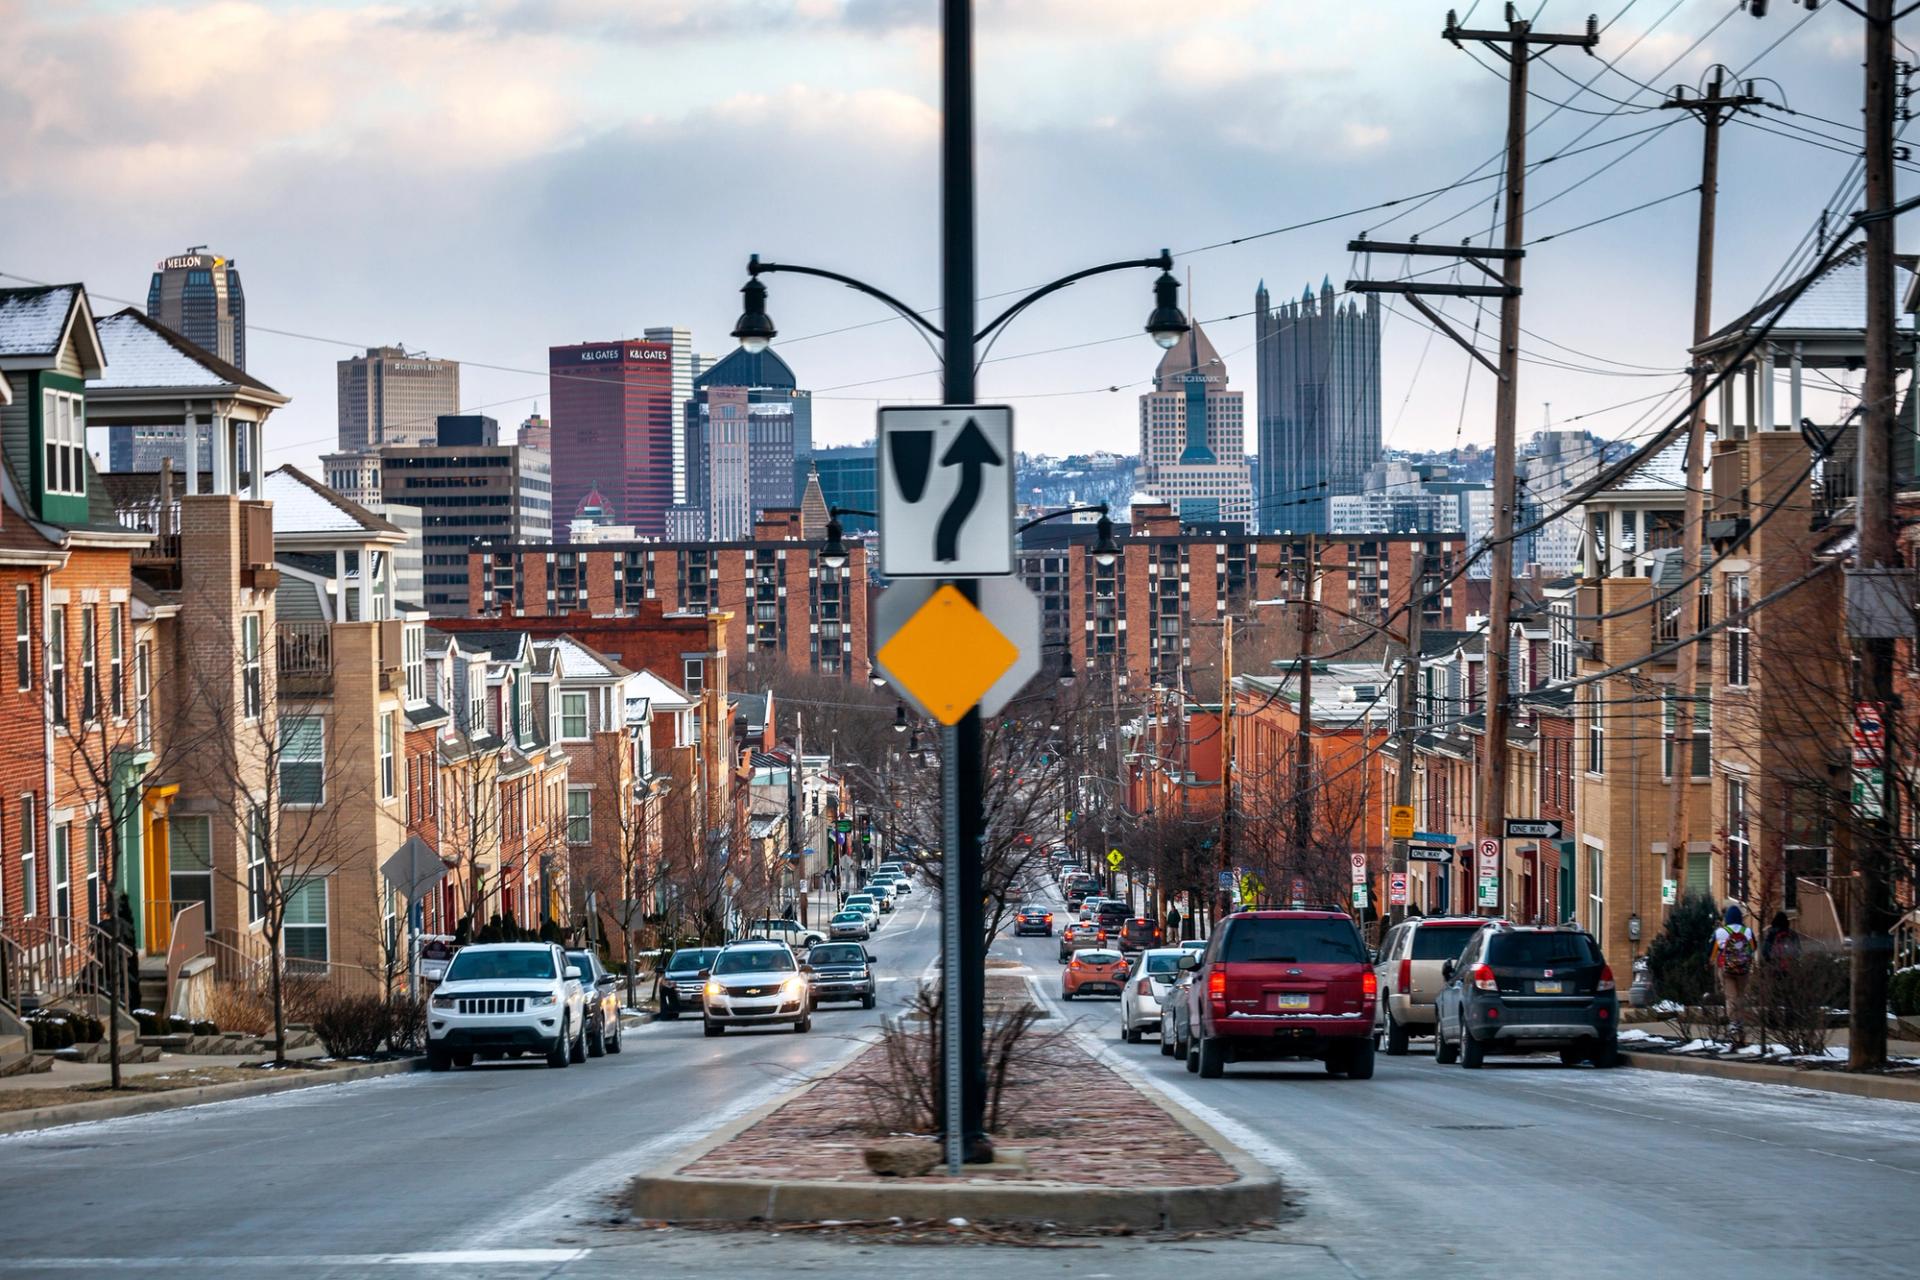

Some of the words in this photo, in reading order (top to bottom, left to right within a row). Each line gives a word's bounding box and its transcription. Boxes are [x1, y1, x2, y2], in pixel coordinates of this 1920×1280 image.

[167, 256, 202, 269] MELLON
[581, 351, 595, 361] K&L
[595, 350, 619, 360] GATES
[629, 350, 643, 359] K&L
[643, 350, 668, 360] GATES
[1511, 825, 1528, 833] ONE
[1529, 825, 1546, 833] WAY
[1413, 850, 1425, 858] ONE
